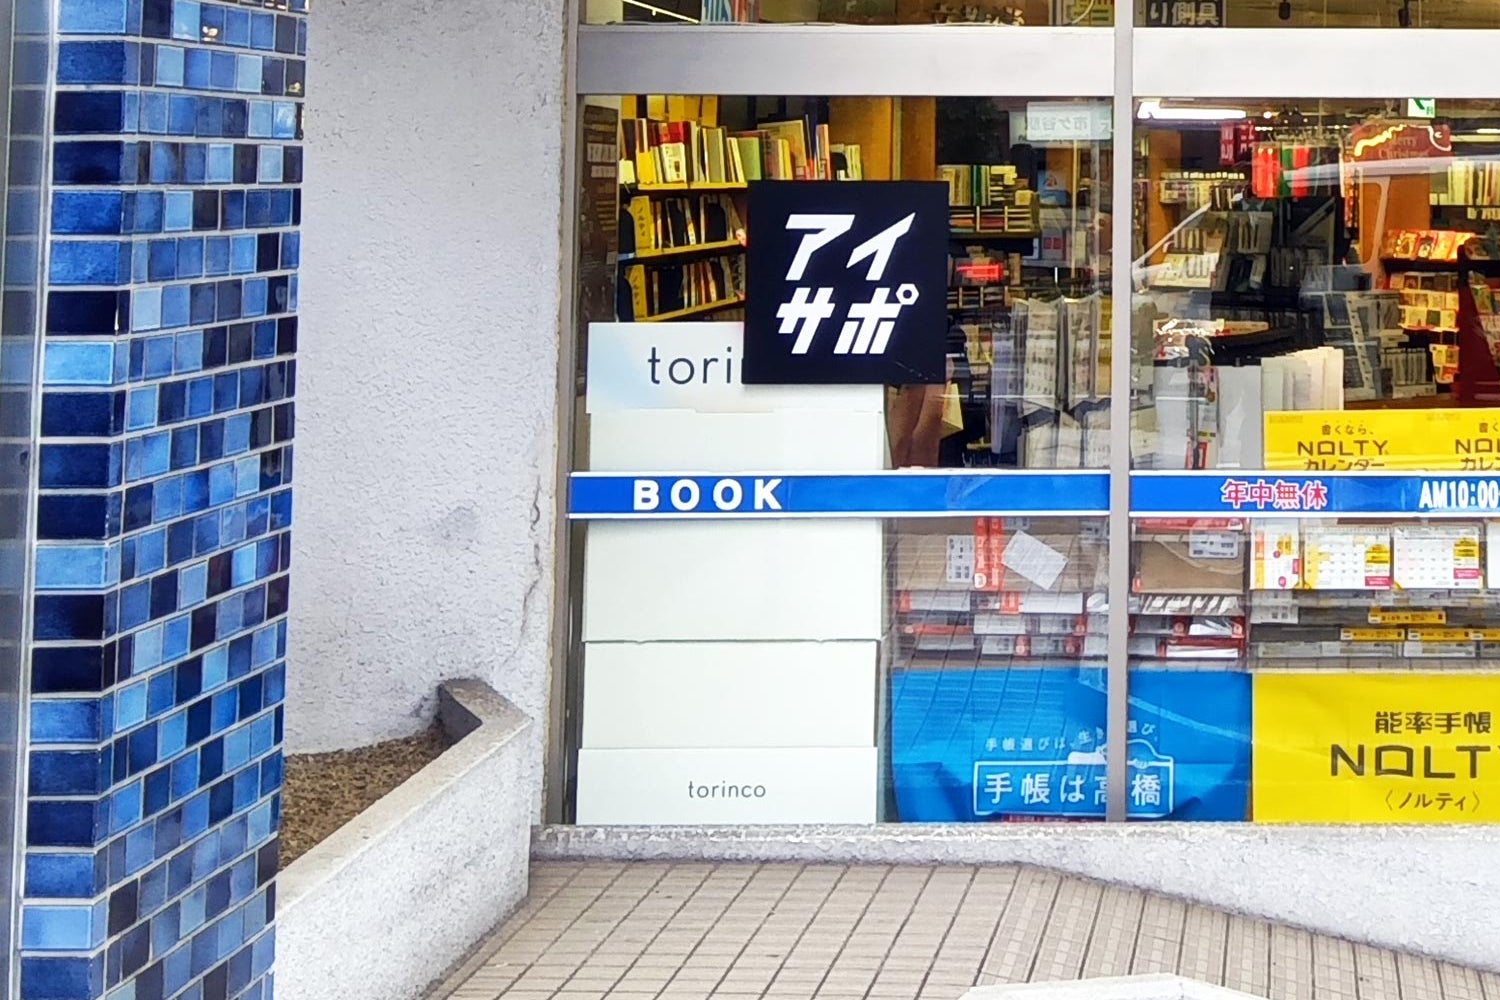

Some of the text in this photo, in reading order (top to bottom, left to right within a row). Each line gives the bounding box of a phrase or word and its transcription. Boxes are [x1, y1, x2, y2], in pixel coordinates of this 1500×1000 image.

[785, 212, 916, 281] アイ
[776, 283, 920, 355] サポ
[647, 346, 744, 385] tori
[1298, 440, 1388, 456] NOLTY
[633, 478, 782, 512] BOOK
[1221, 478, 1328, 511] 年中無休
[1375, 711, 1491, 734] 能率手帳
[687, 780, 767, 799] torinco
